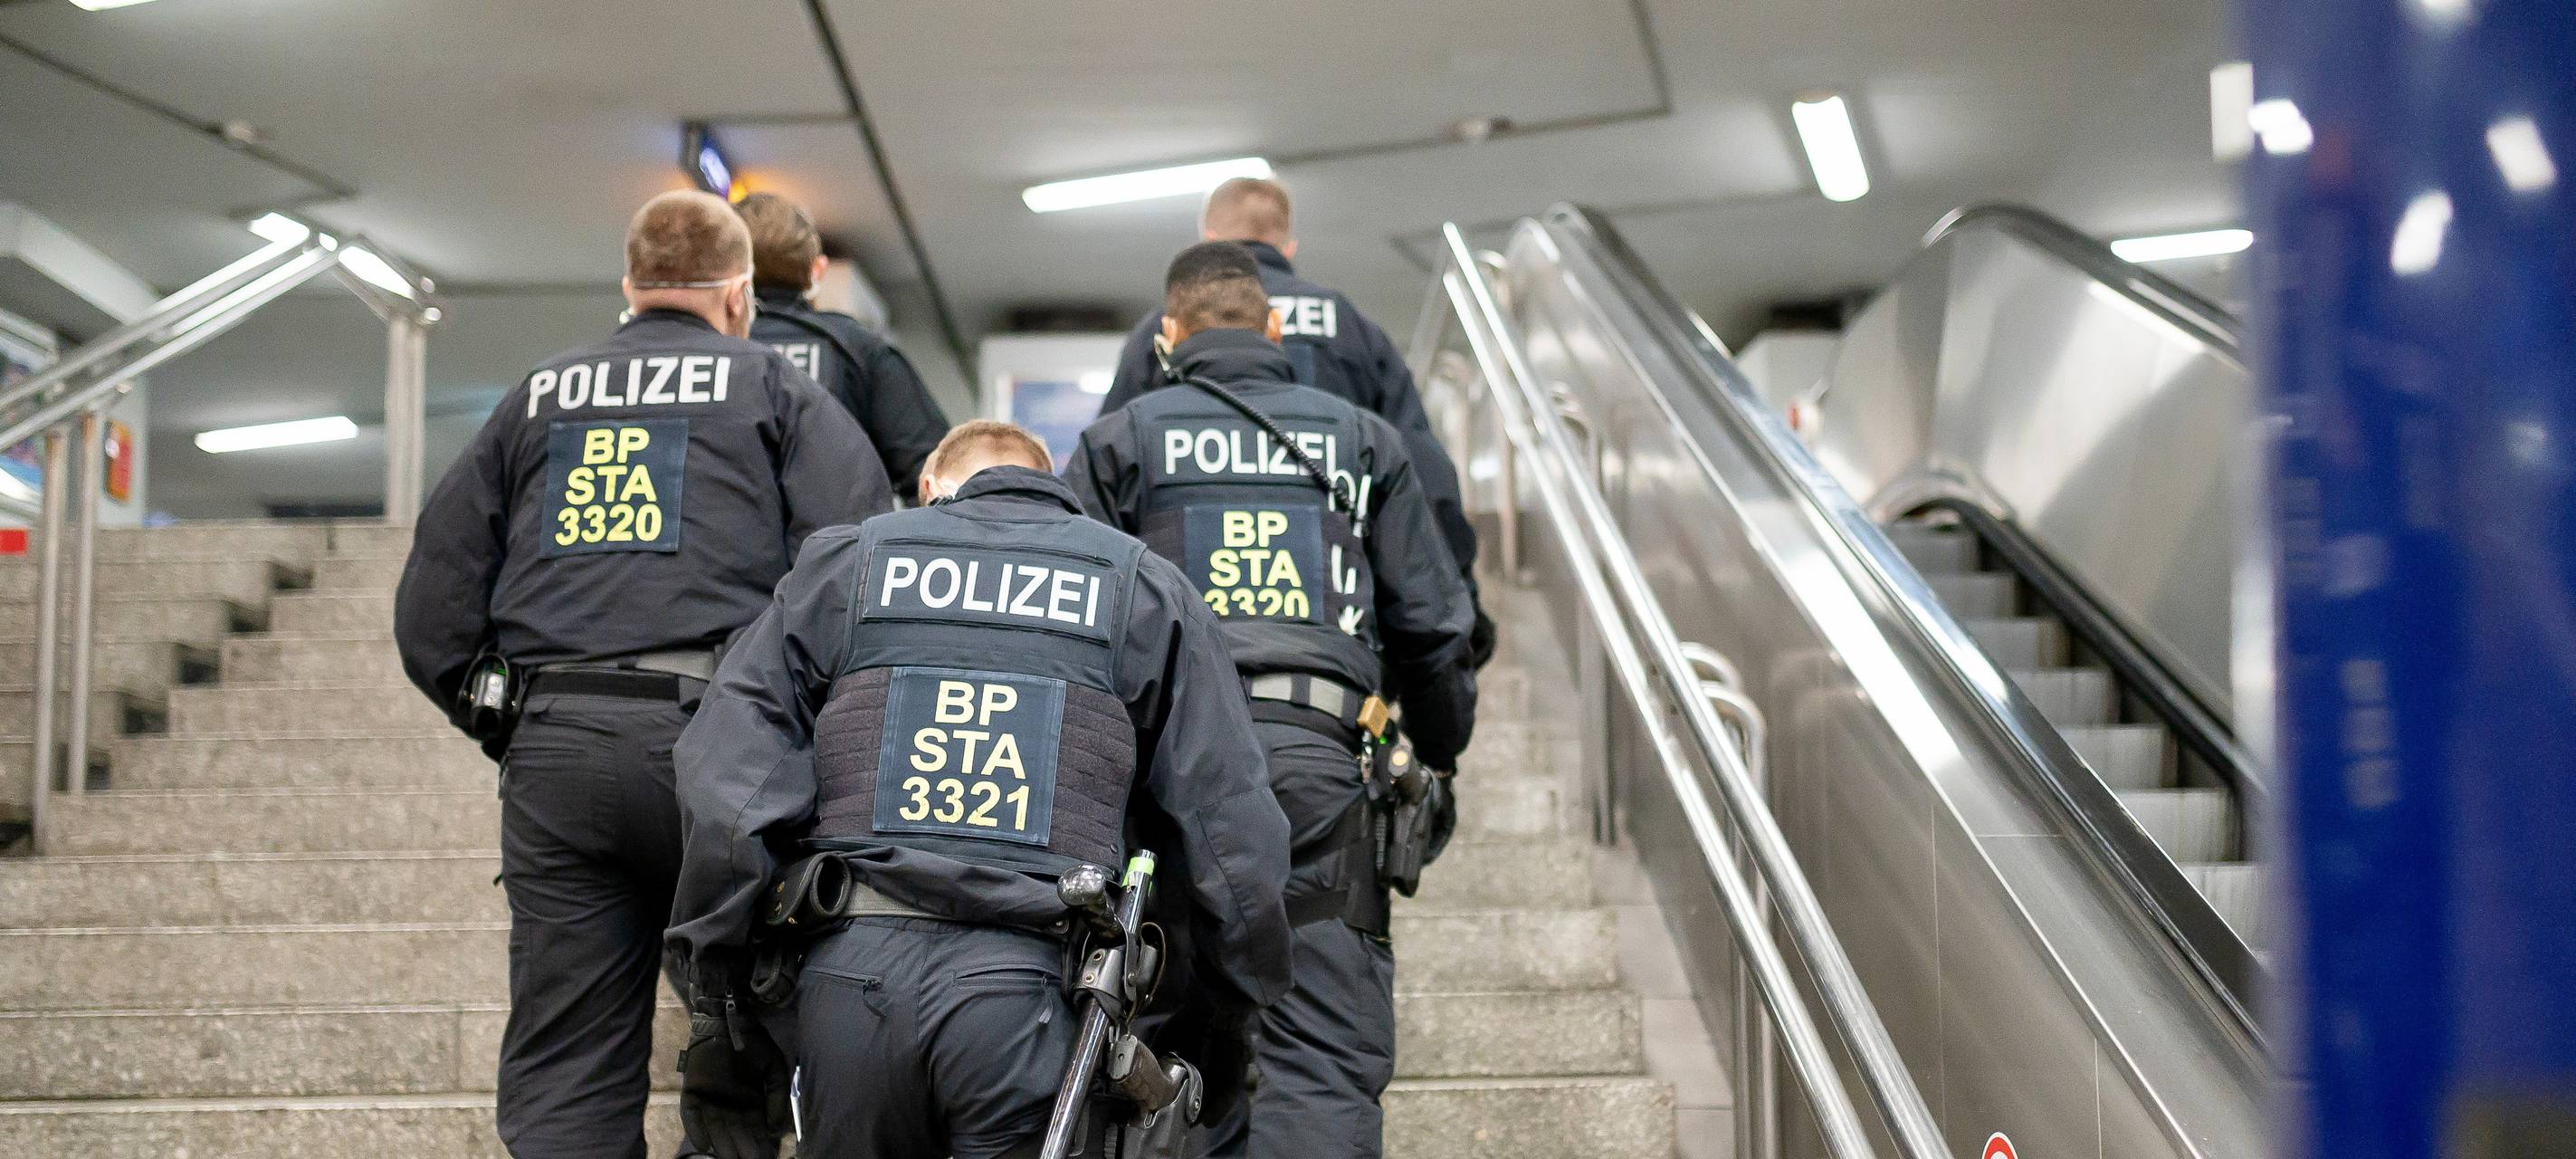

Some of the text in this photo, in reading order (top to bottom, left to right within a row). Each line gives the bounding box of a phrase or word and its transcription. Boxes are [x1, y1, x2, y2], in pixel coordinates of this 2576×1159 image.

[527, 355, 731, 419] POLIZEI
[583, 427, 650, 465] BP
[1164, 428, 1337, 476] POLIZEI
[565, 465, 657, 505] STA
[555, 503, 663, 546] 3320
[1223, 510, 1289, 548] BP
[1208, 549, 1302, 588] STA
[880, 557, 1101, 627] POLIZEI
[1204, 588, 1310, 618] 3320
[935, 680, 1018, 726] BP
[910, 727, 1026, 780] STA
[899, 776, 1030, 831] 3321
